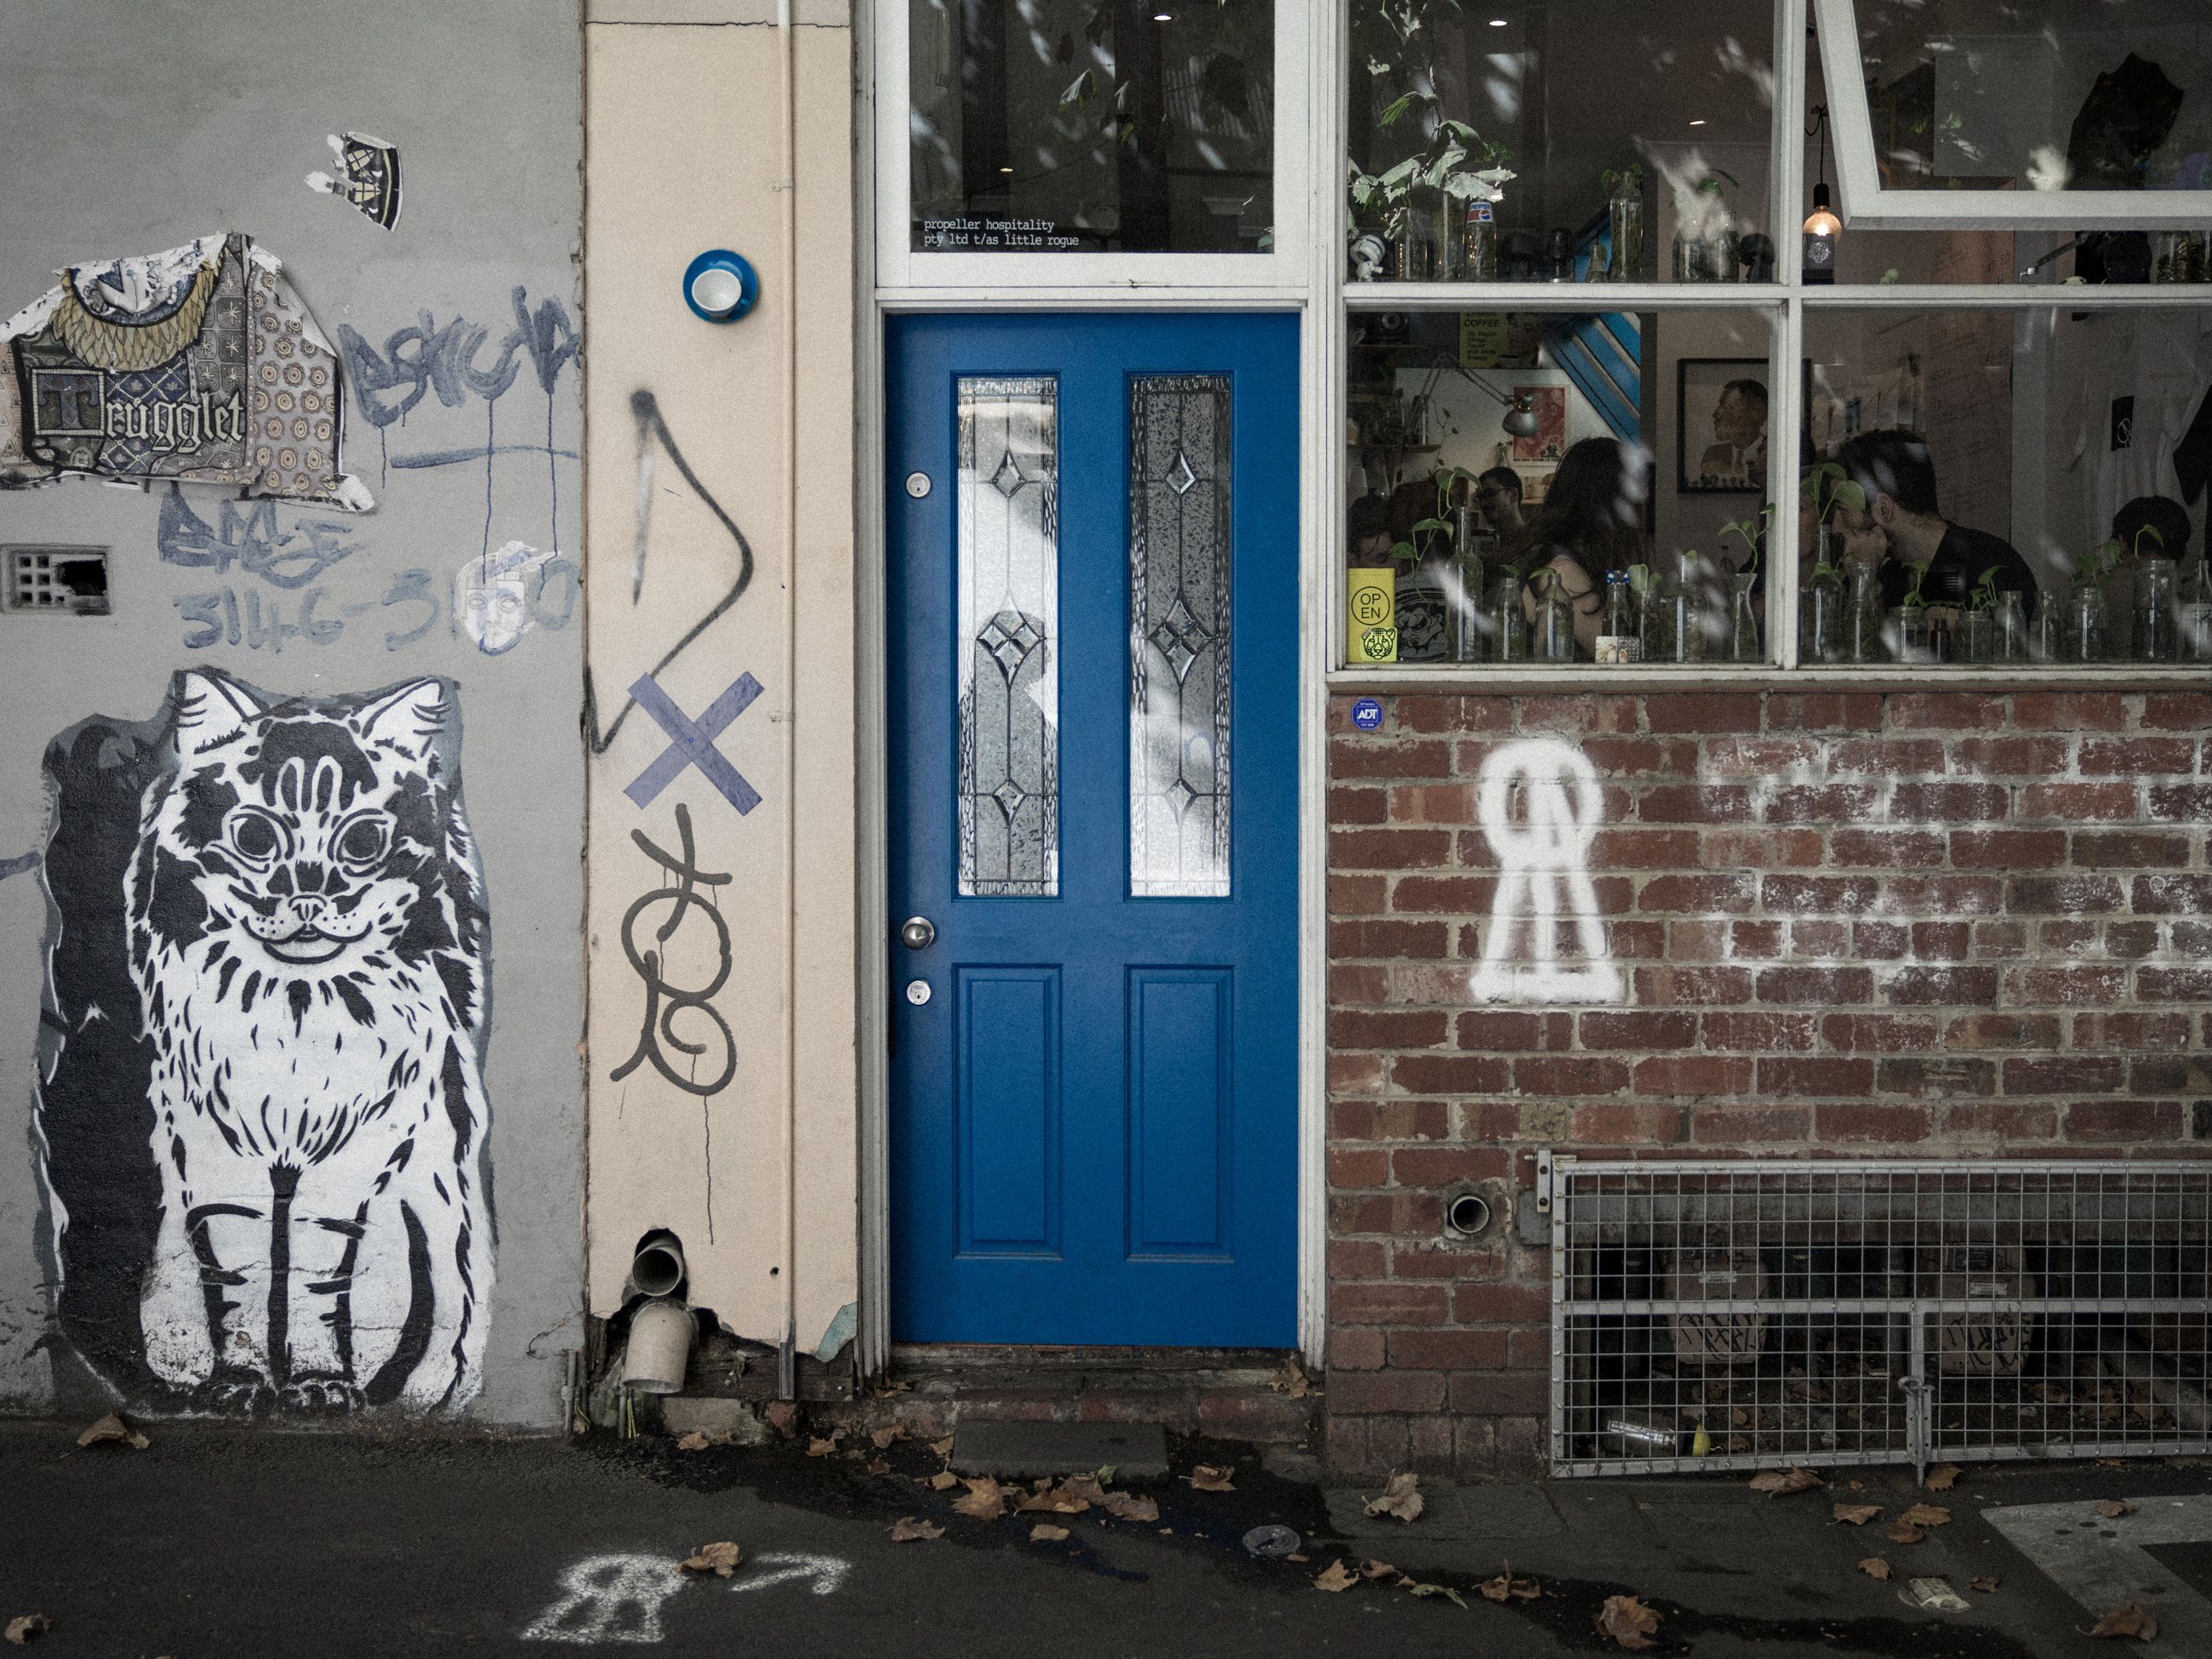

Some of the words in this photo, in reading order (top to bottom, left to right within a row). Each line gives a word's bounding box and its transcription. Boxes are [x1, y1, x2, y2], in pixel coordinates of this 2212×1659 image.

[924, 219, 980, 231] propeller
[986, 219, 1054, 233] hospitality
[924, 234, 944, 247] pty
[949, 234, 968, 245] ltd
[973, 233, 999, 245] t/as
[1005, 234, 1042, 245] little
[1047, 237, 1079, 248] rogue
[33, 368, 247, 453] Trugglet
[1360, 593, 1381, 605] OP
[1361, 607, 1380, 619] EN
[1357, 709, 1378, 720] ADT
